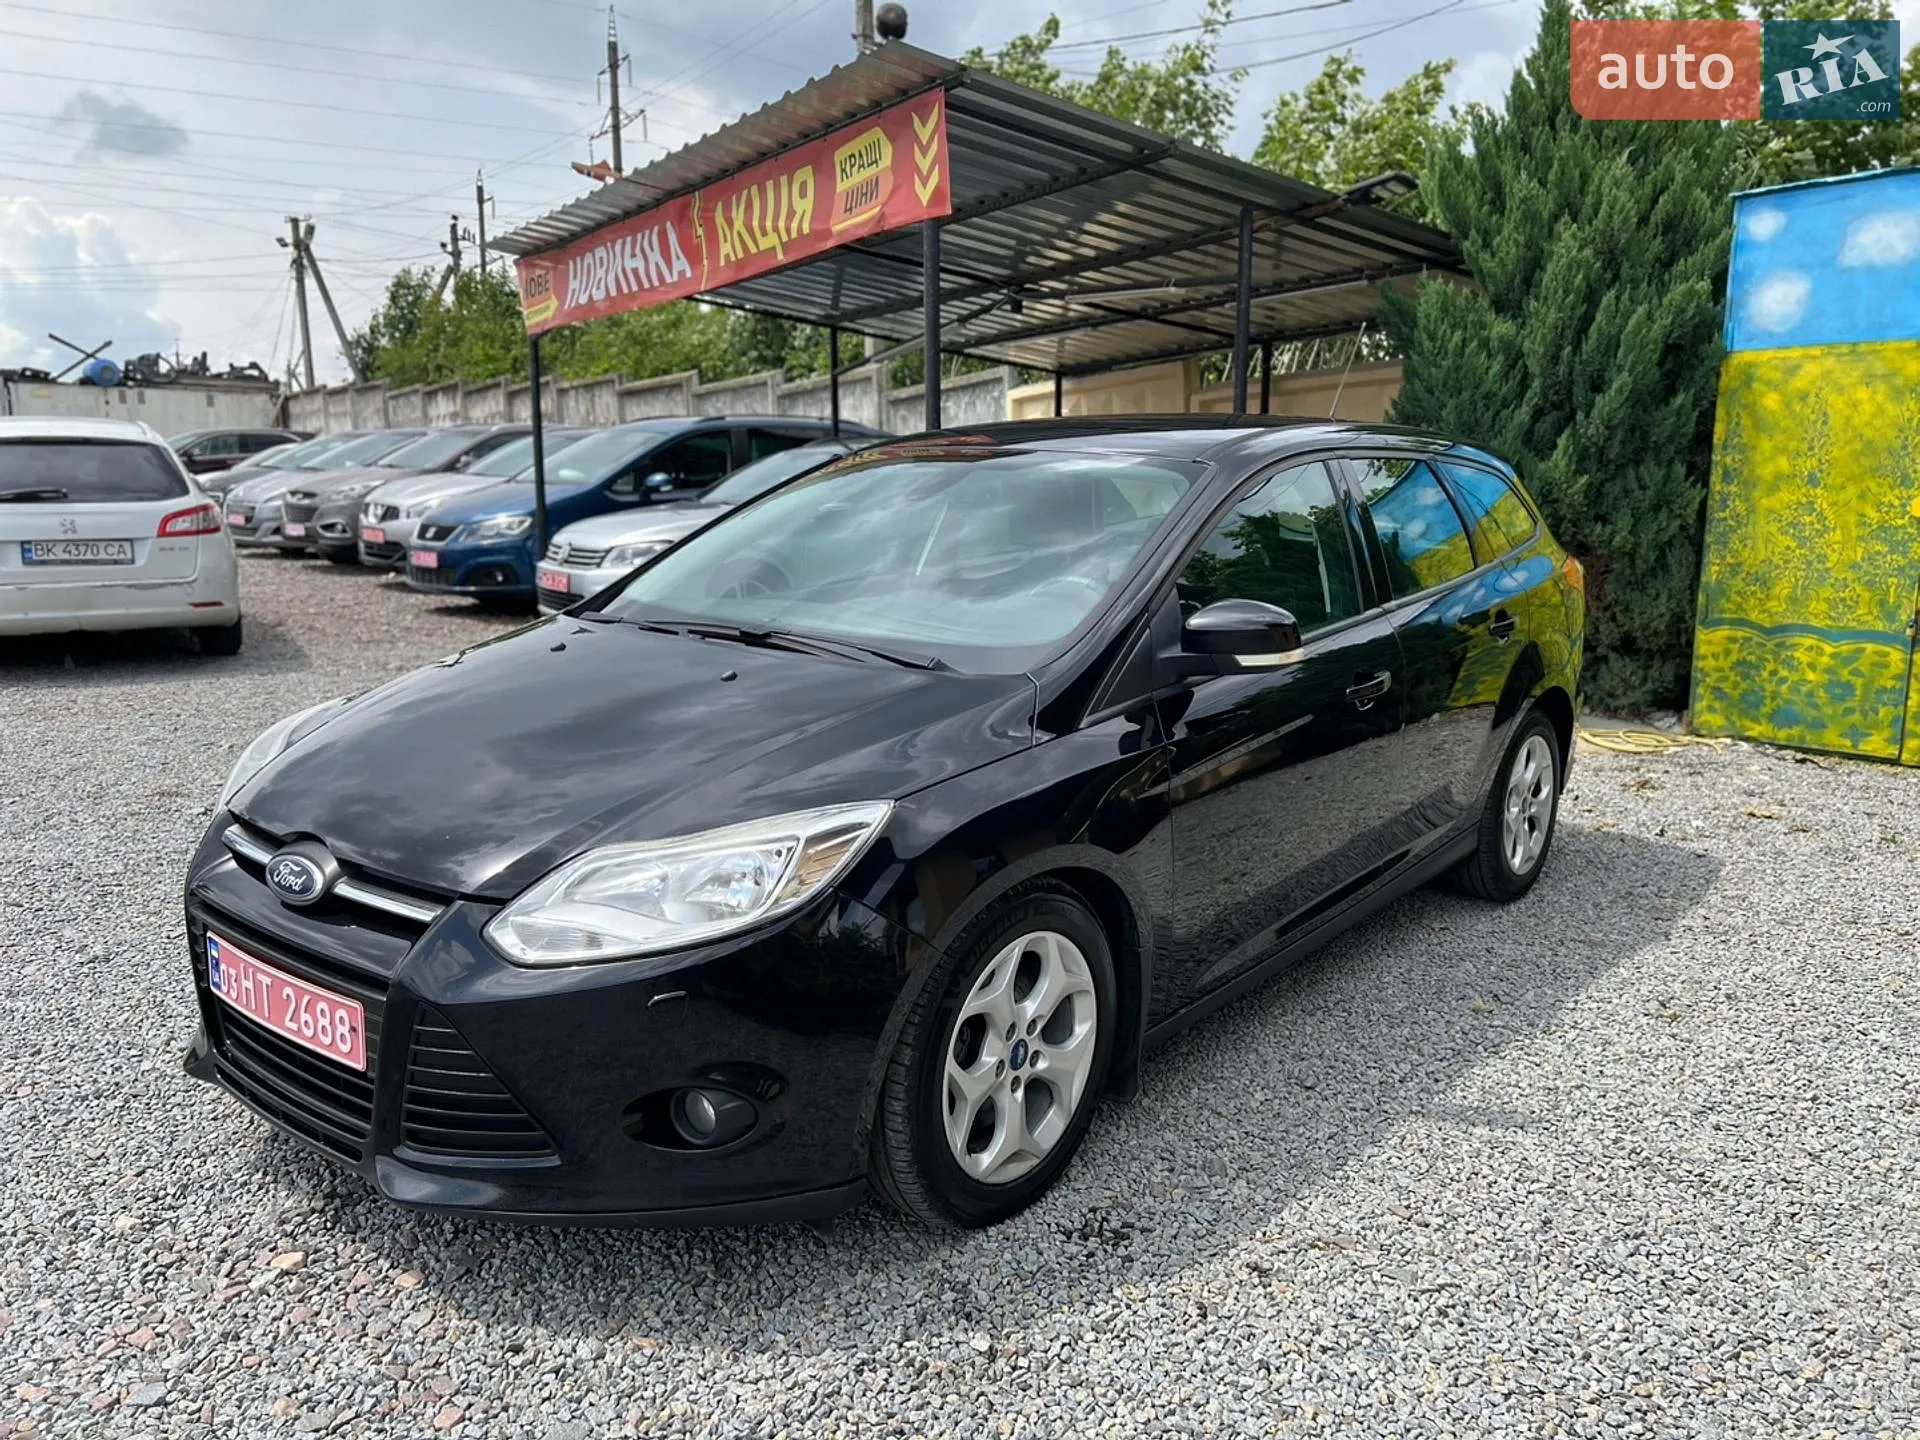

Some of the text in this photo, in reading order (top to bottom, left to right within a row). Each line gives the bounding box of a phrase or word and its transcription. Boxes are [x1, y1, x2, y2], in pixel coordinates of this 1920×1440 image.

[838, 136, 882, 183] КРАЩІ
[843, 175, 880, 215] ЦІНИ
[563, 165, 815, 311] НОВИНКА АКЦІЯ
[34, 543, 128, 557] BK 4370 CA
[273, 861, 307, 891] Ford
[282, 986, 352, 1054] 2688
